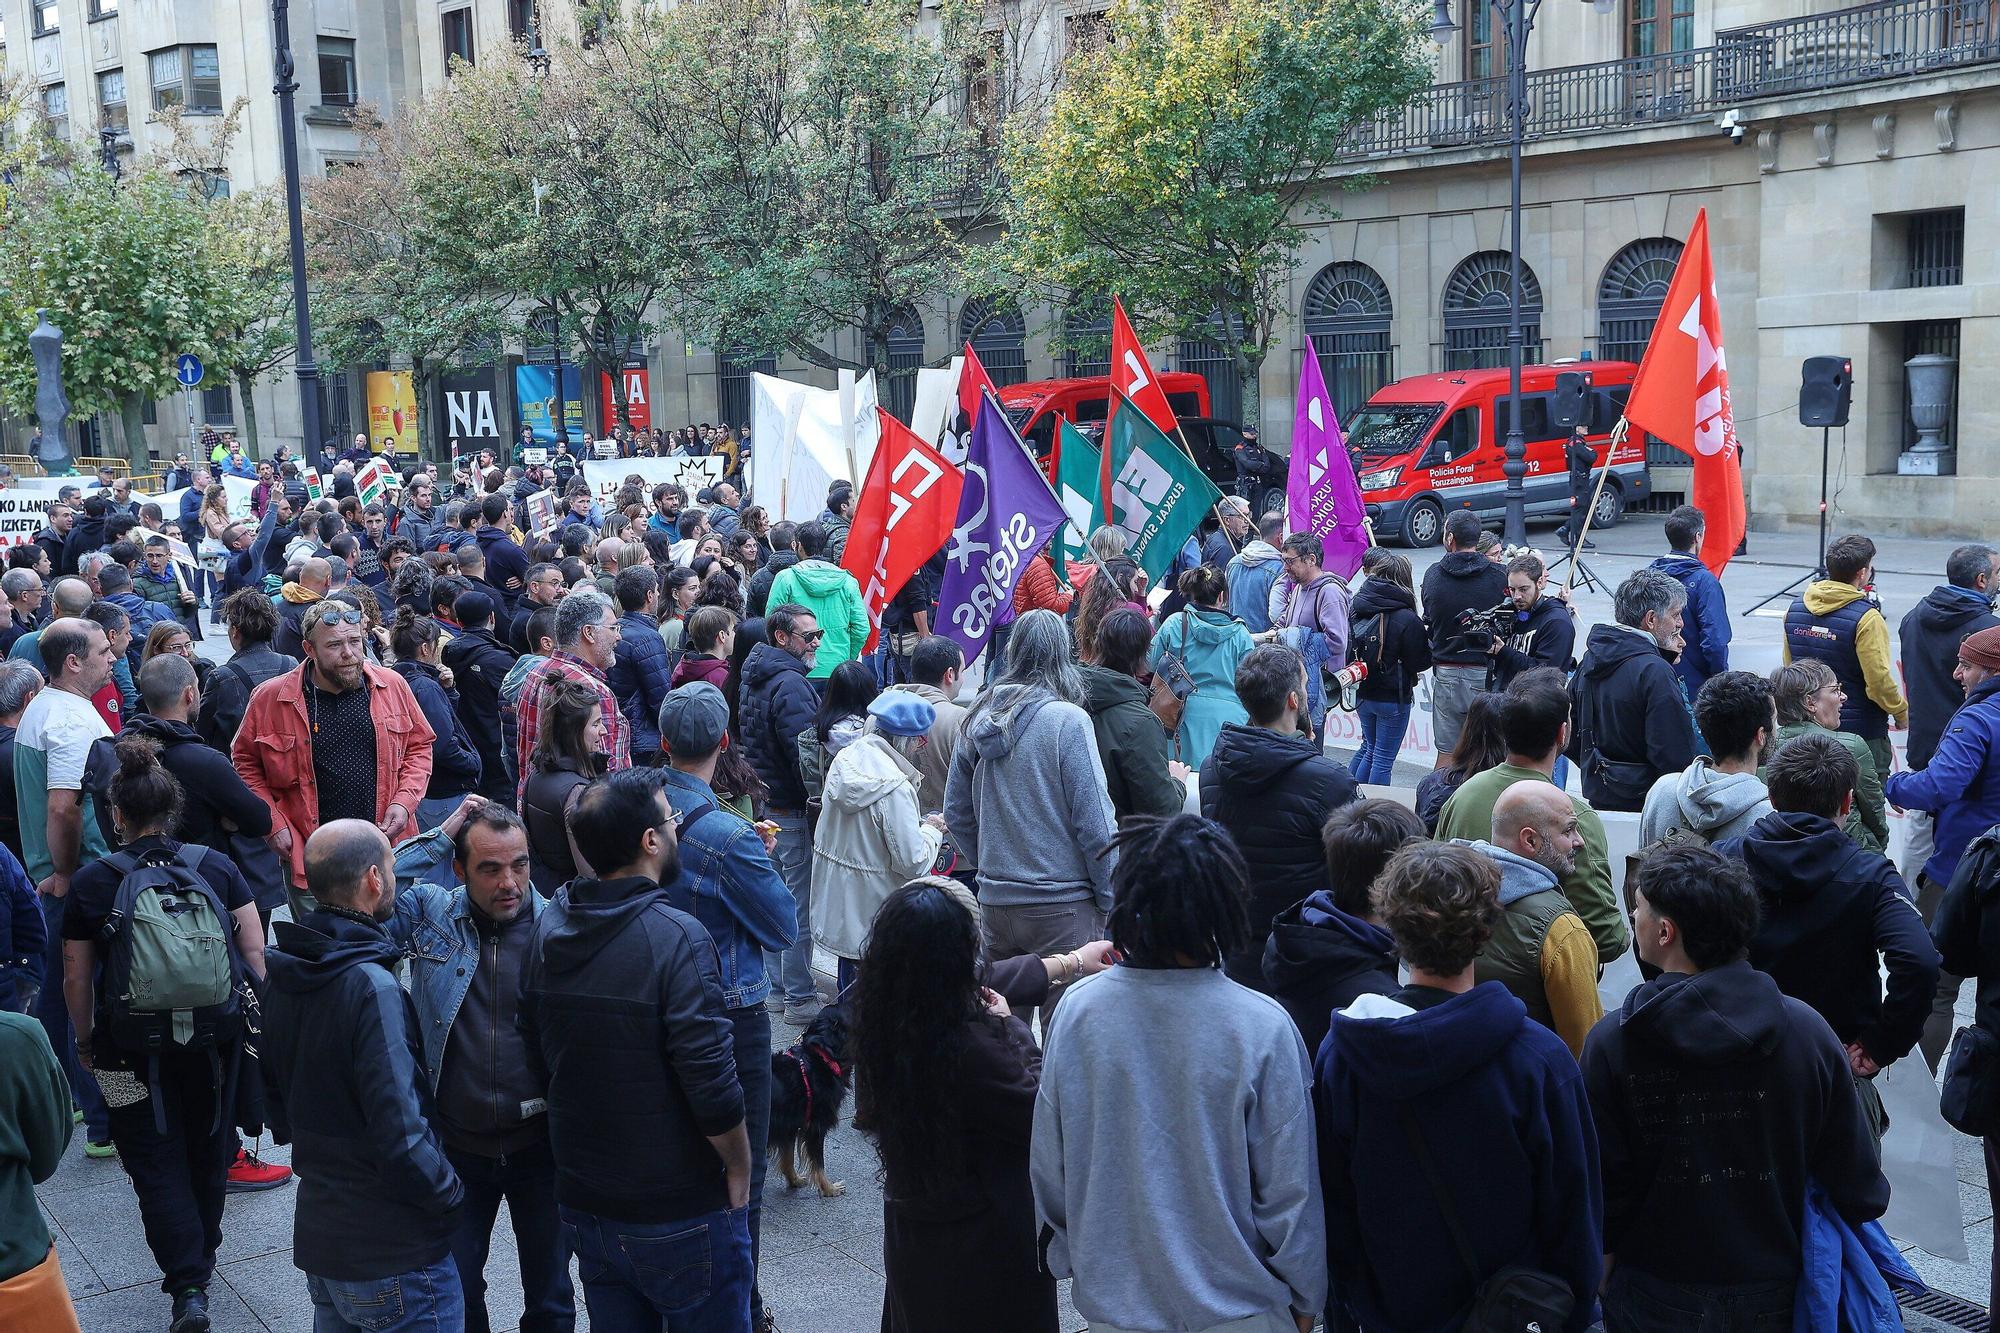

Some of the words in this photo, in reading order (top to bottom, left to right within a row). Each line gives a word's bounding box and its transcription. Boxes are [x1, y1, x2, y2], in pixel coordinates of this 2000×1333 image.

[445, 391, 499, 437] NA
[1455, 464, 1474, 473] Foral
[1431, 475, 1474, 488] Foruzaingoa
